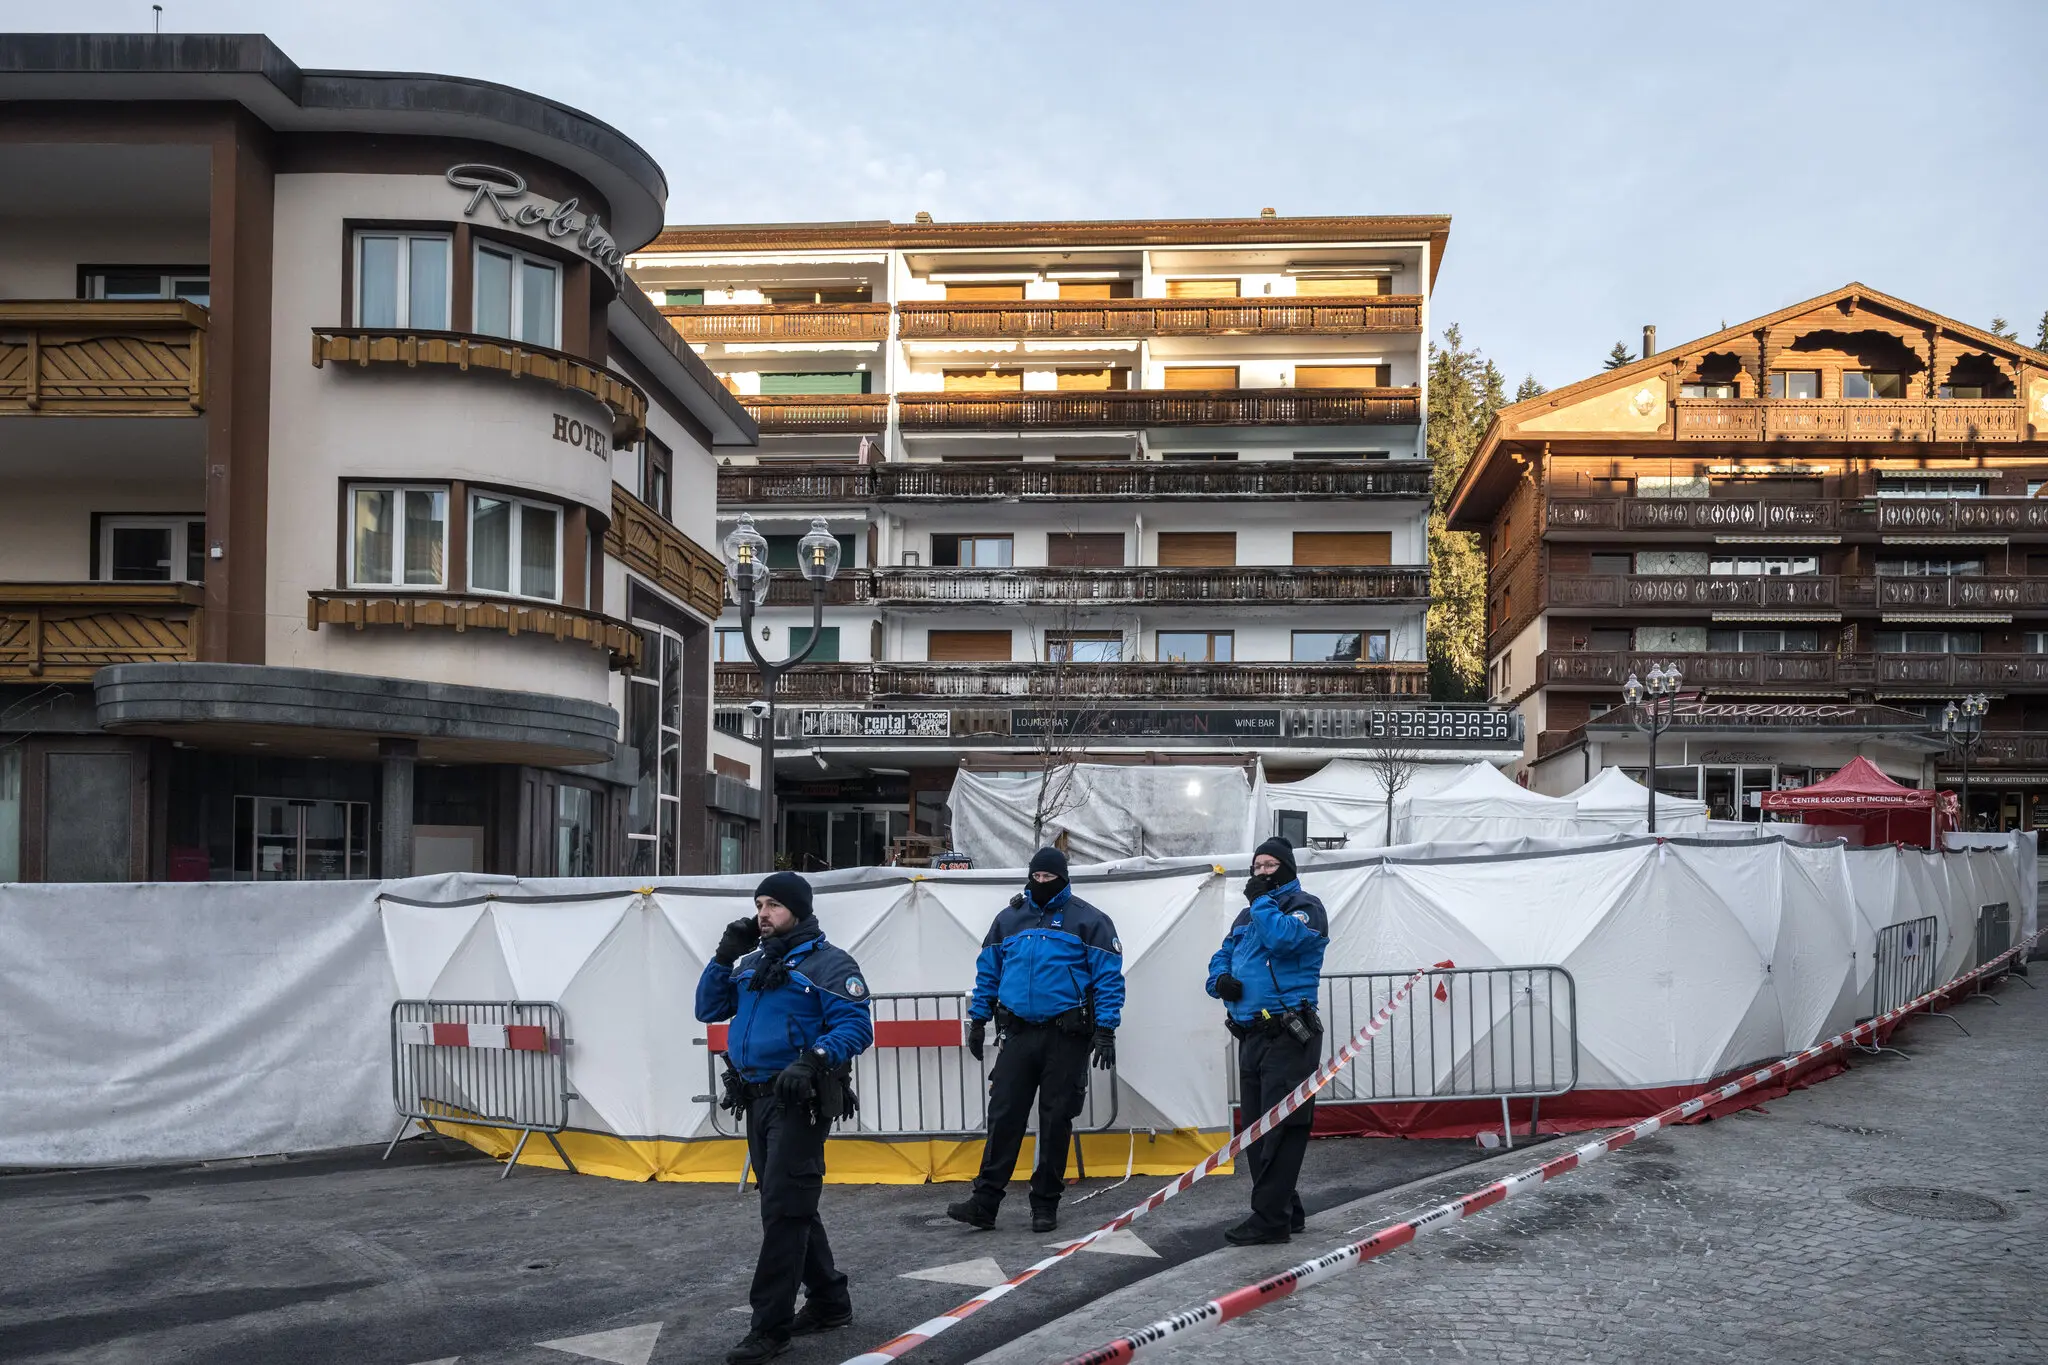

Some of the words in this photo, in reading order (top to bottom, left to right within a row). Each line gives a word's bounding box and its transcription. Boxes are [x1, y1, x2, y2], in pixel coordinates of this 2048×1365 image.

[552, 413, 608, 462] HOTEL
[864, 714, 906, 729] rental
[1016, 718, 1050, 727] LOUNGE
[1052, 718, 1069, 727] BAR
[1235, 719, 1256, 727] WINE
[1258, 719, 1275, 727] BAR
[1993, 775, 2040, 783] ARCHITECTURE
